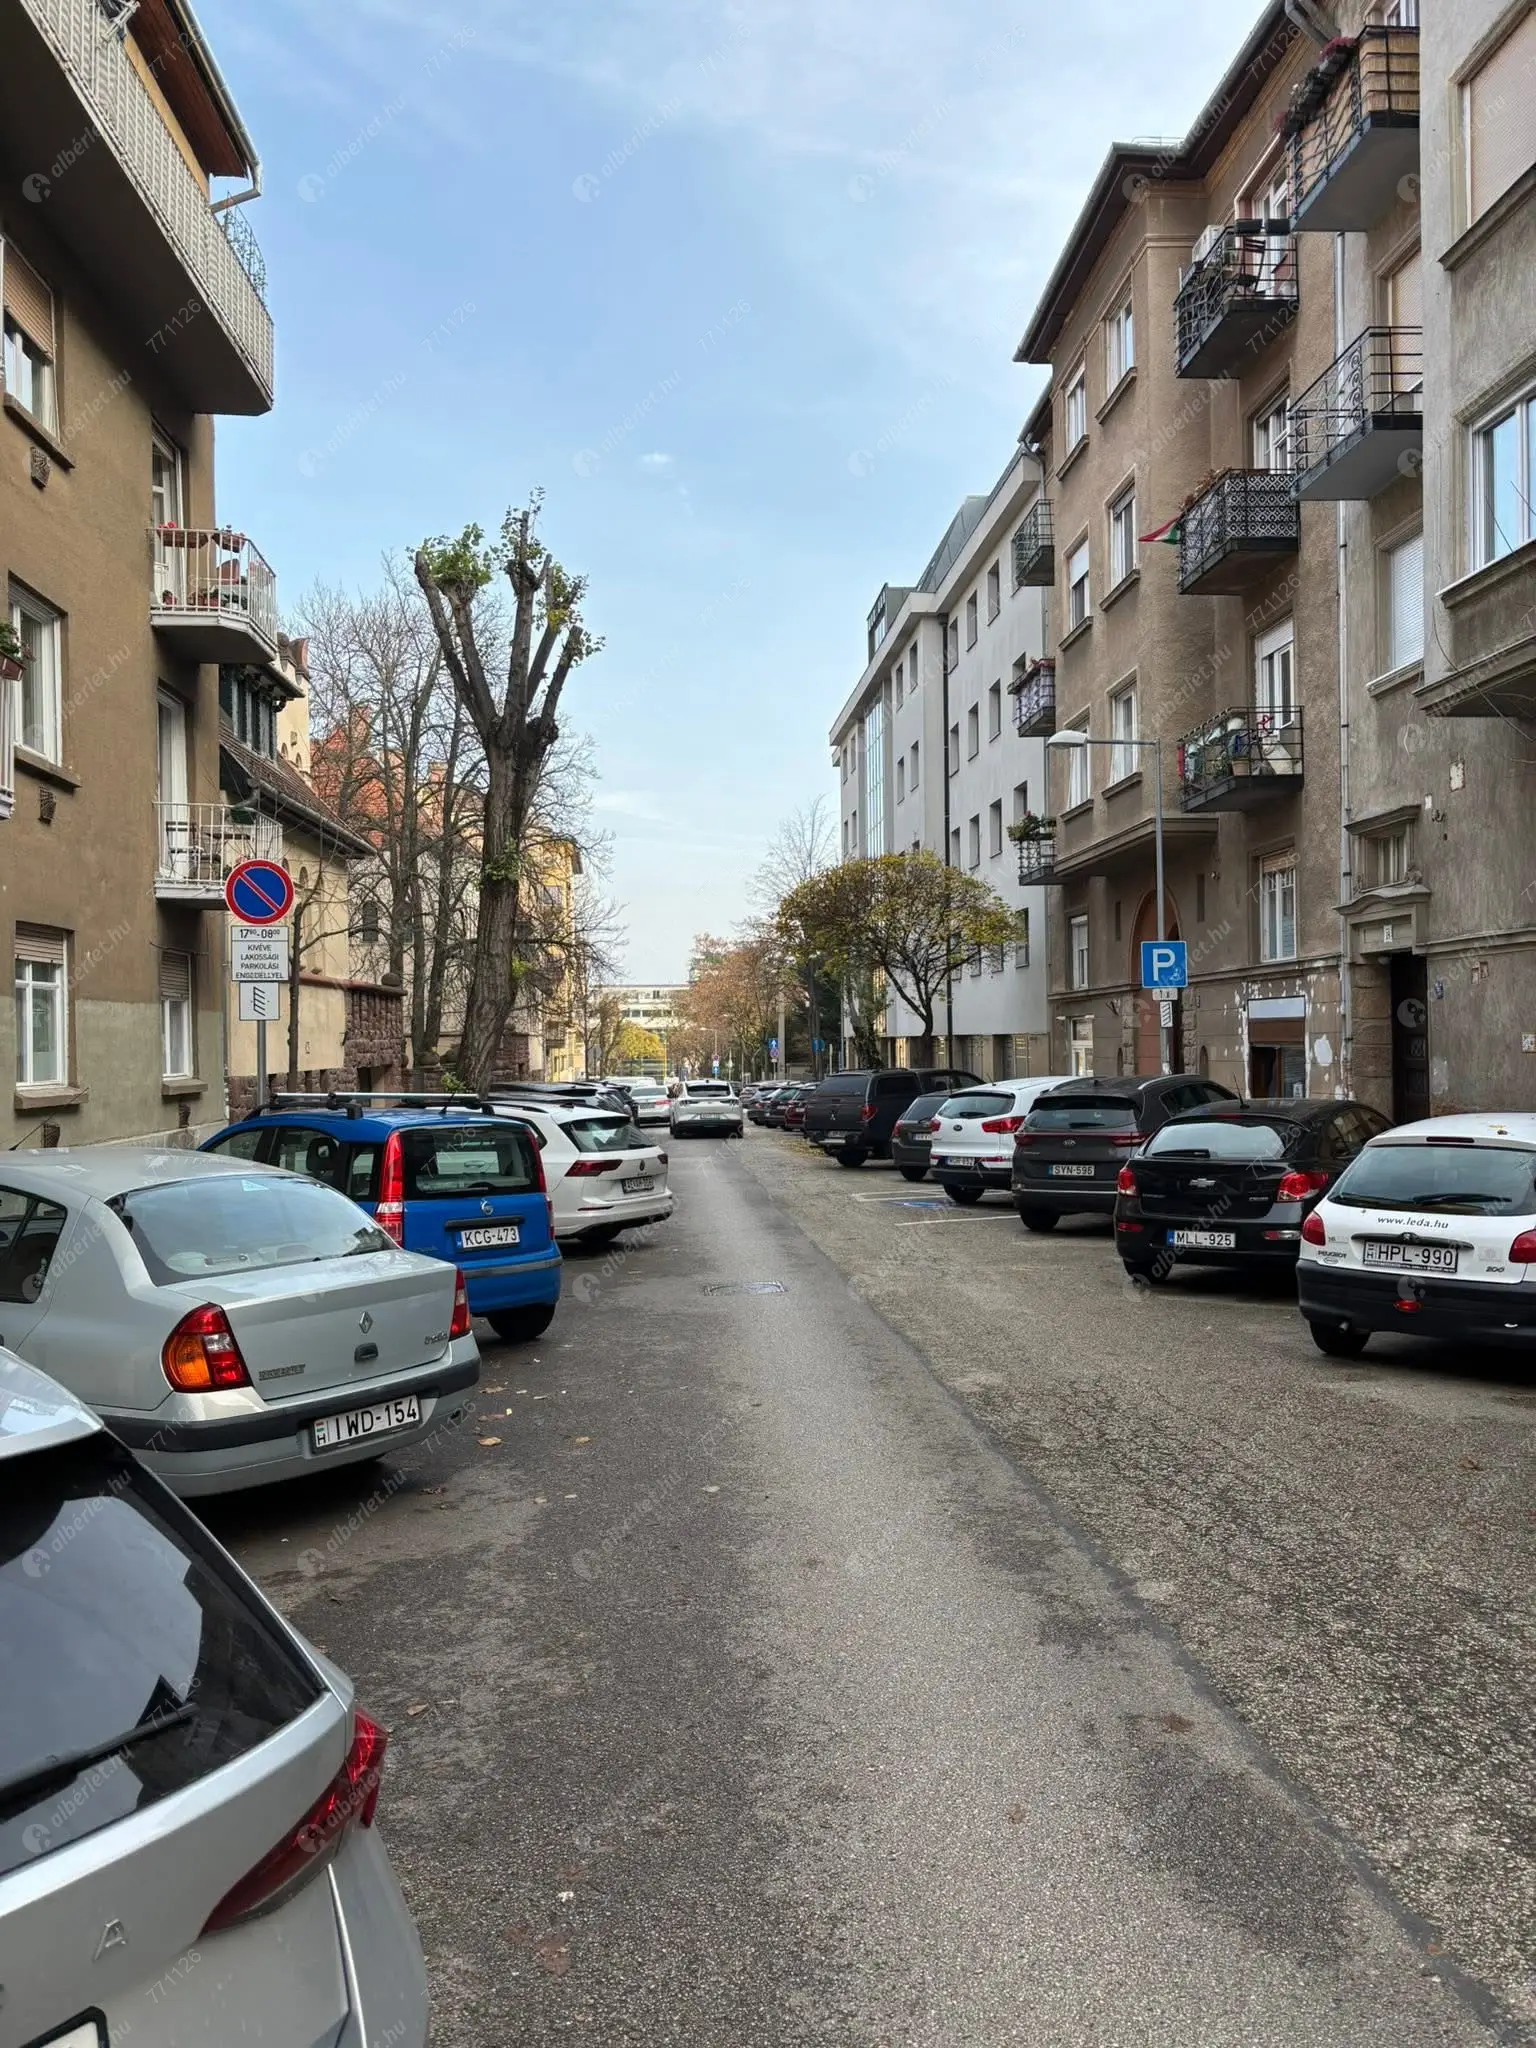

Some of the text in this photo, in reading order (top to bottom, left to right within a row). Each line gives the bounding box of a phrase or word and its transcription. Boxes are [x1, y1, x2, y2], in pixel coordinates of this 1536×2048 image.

[247, 943, 272, 951] KIVÉVE
[1152, 948, 1175, 982] P
[1377, 1216, 1449, 1230] www.leda.hu
[464, 1227, 518, 1246] KCG-473
[1176, 1232, 1232, 1246] MLL-925
[1378, 1244, 1453, 1267] HPL-990
[317, 1399, 417, 1446] H IWD-154
